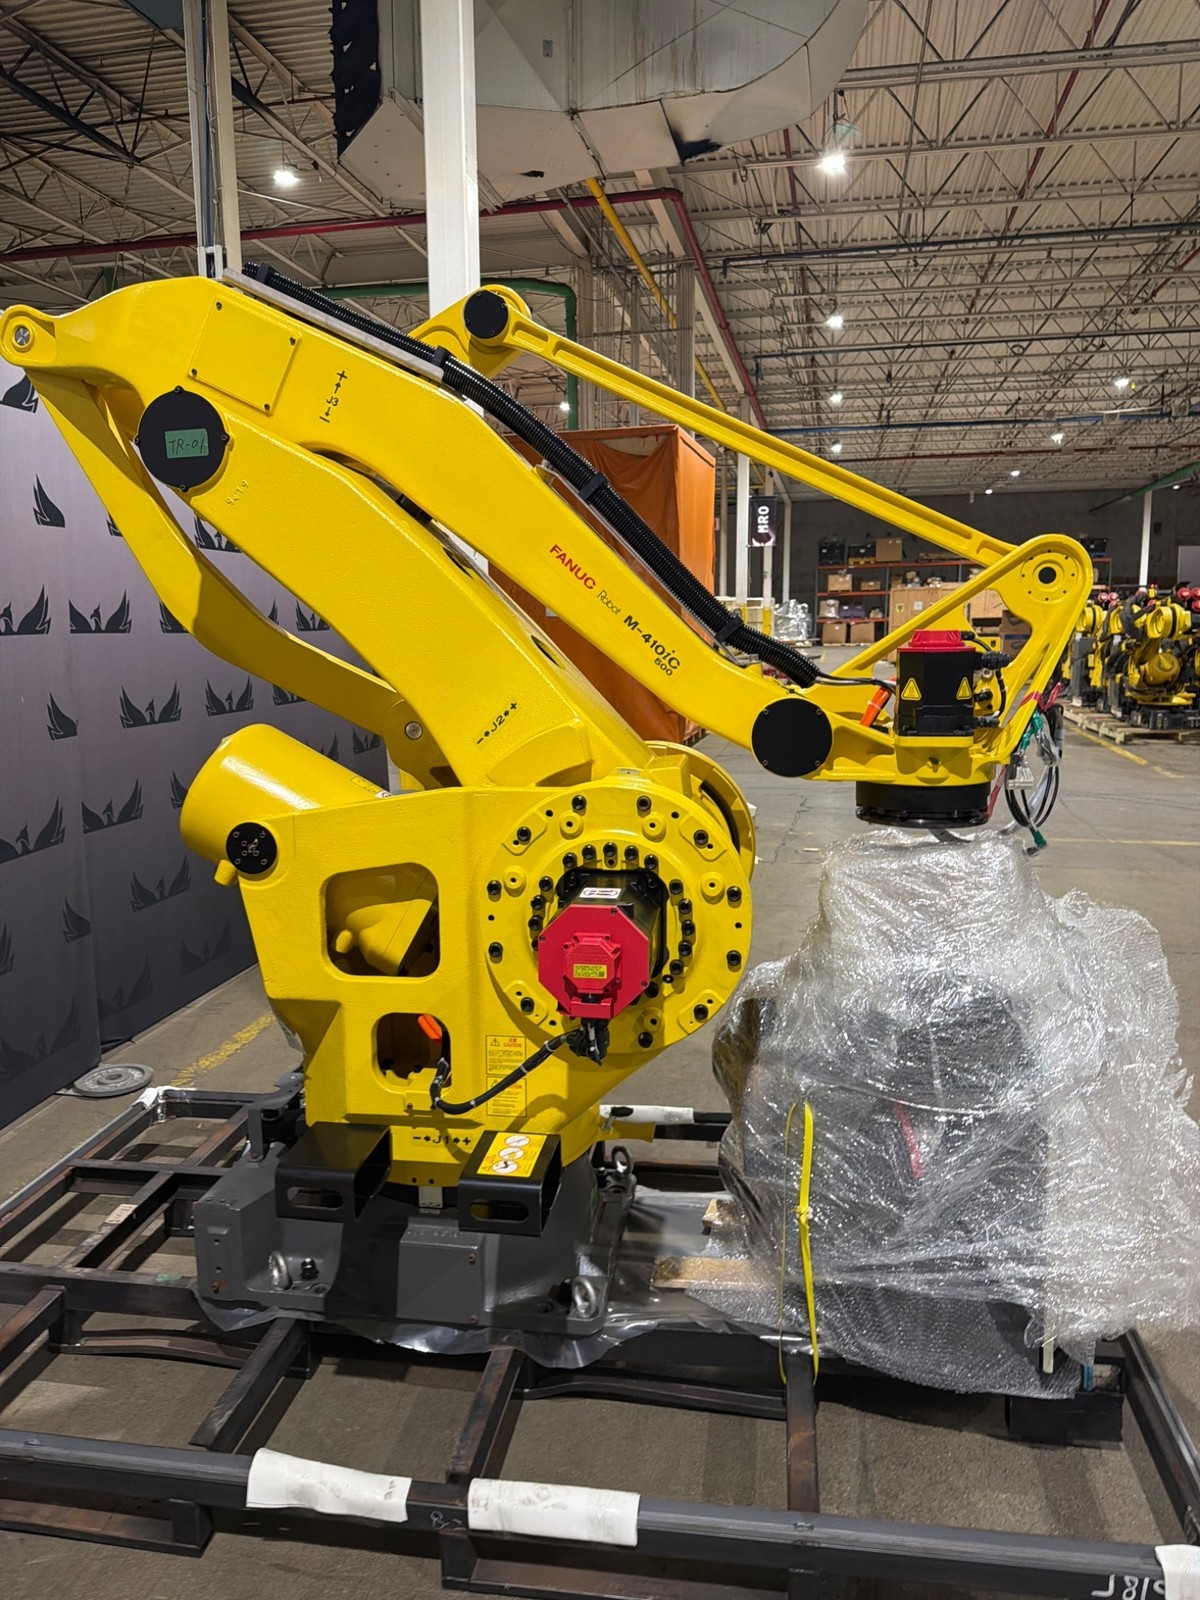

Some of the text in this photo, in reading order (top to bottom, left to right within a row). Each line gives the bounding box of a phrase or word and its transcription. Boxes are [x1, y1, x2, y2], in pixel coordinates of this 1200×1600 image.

[326, 397, 339, 407] J3
[757, 505, 770, 534] MRO
[549, 544, 596, 590] FANUC
[597, 589, 622, 615] Robot
[654, 657, 673, 676] 500
[491, 714, 506, 732] J2
[432, 1135, 450, 1145] J1
